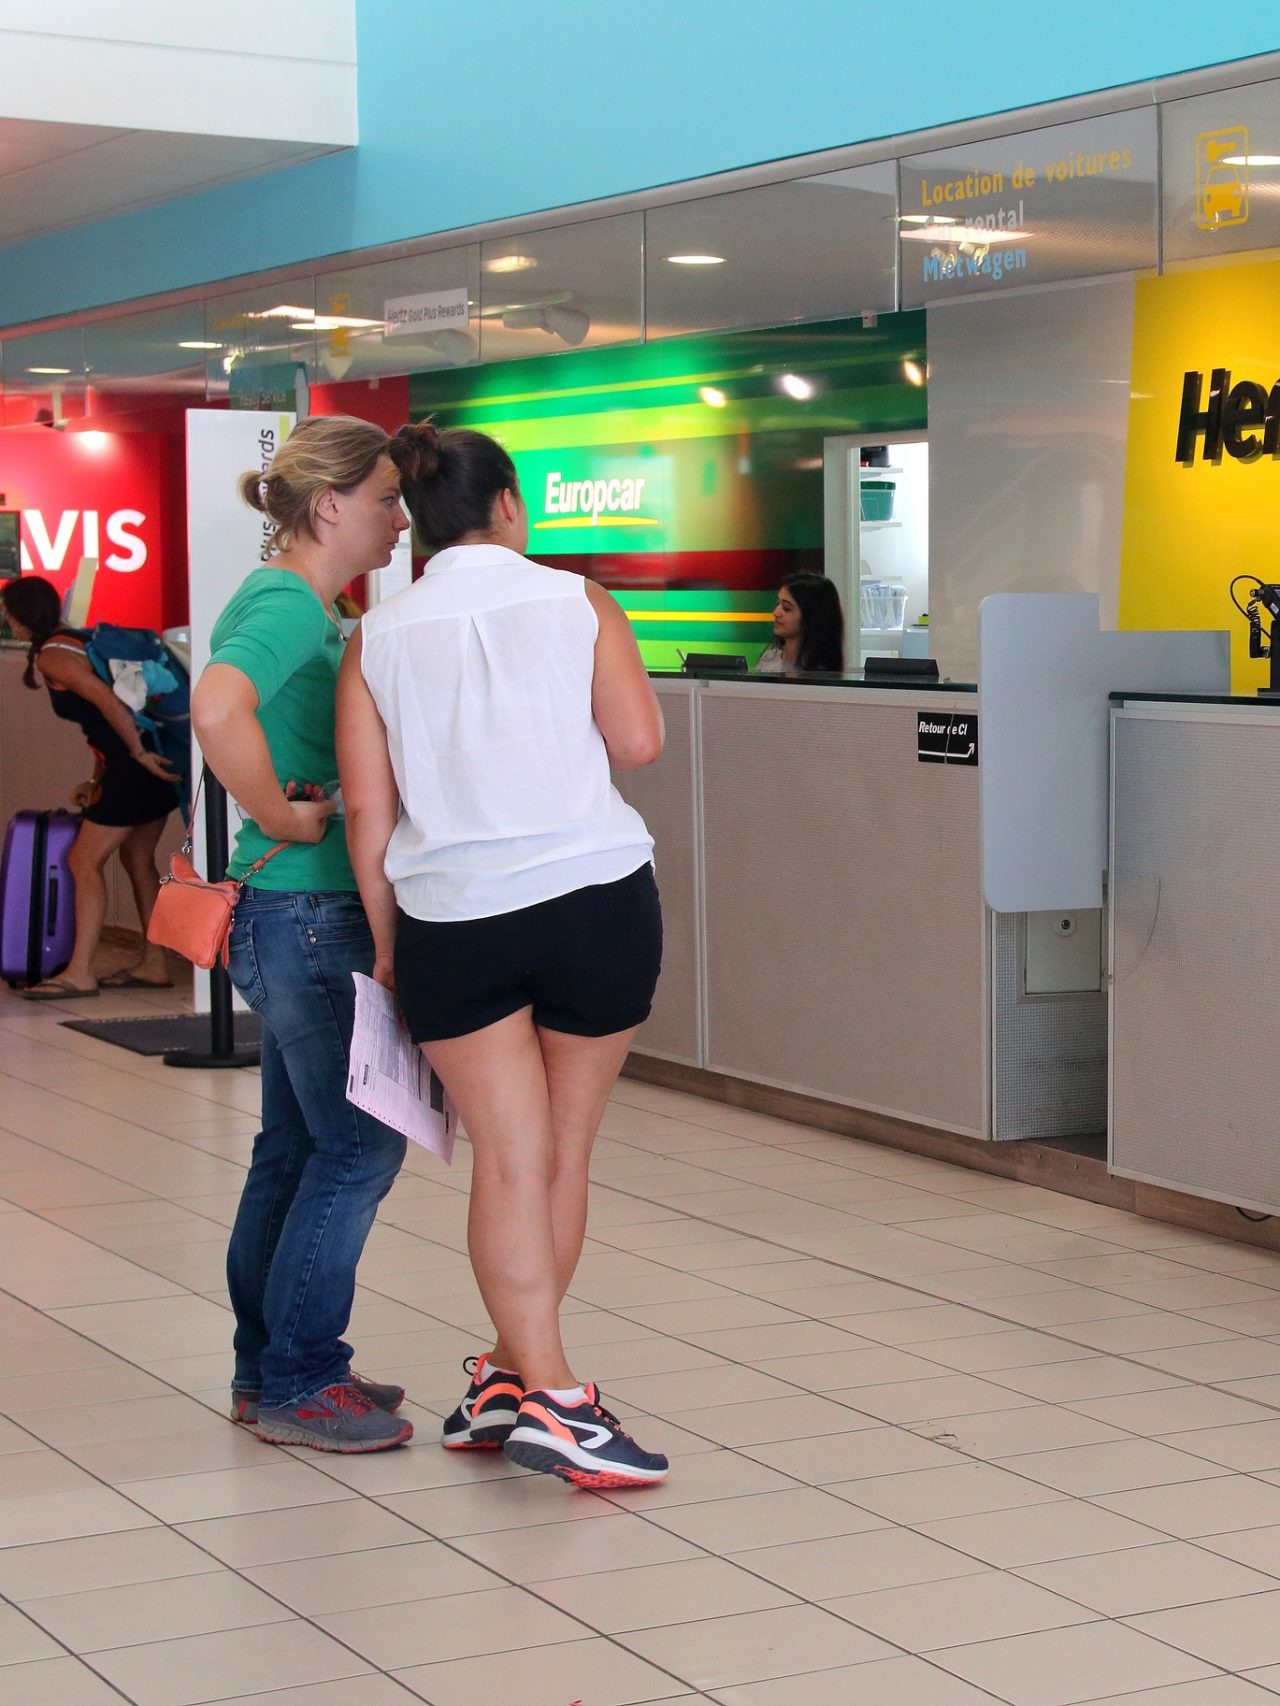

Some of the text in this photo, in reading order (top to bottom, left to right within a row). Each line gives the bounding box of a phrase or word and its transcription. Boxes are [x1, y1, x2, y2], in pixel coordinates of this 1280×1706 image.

[921, 147, 1133, 207] Location de voitures
[544, 471, 646, 527] Europcar
[918, 721, 946, 735] Retour
